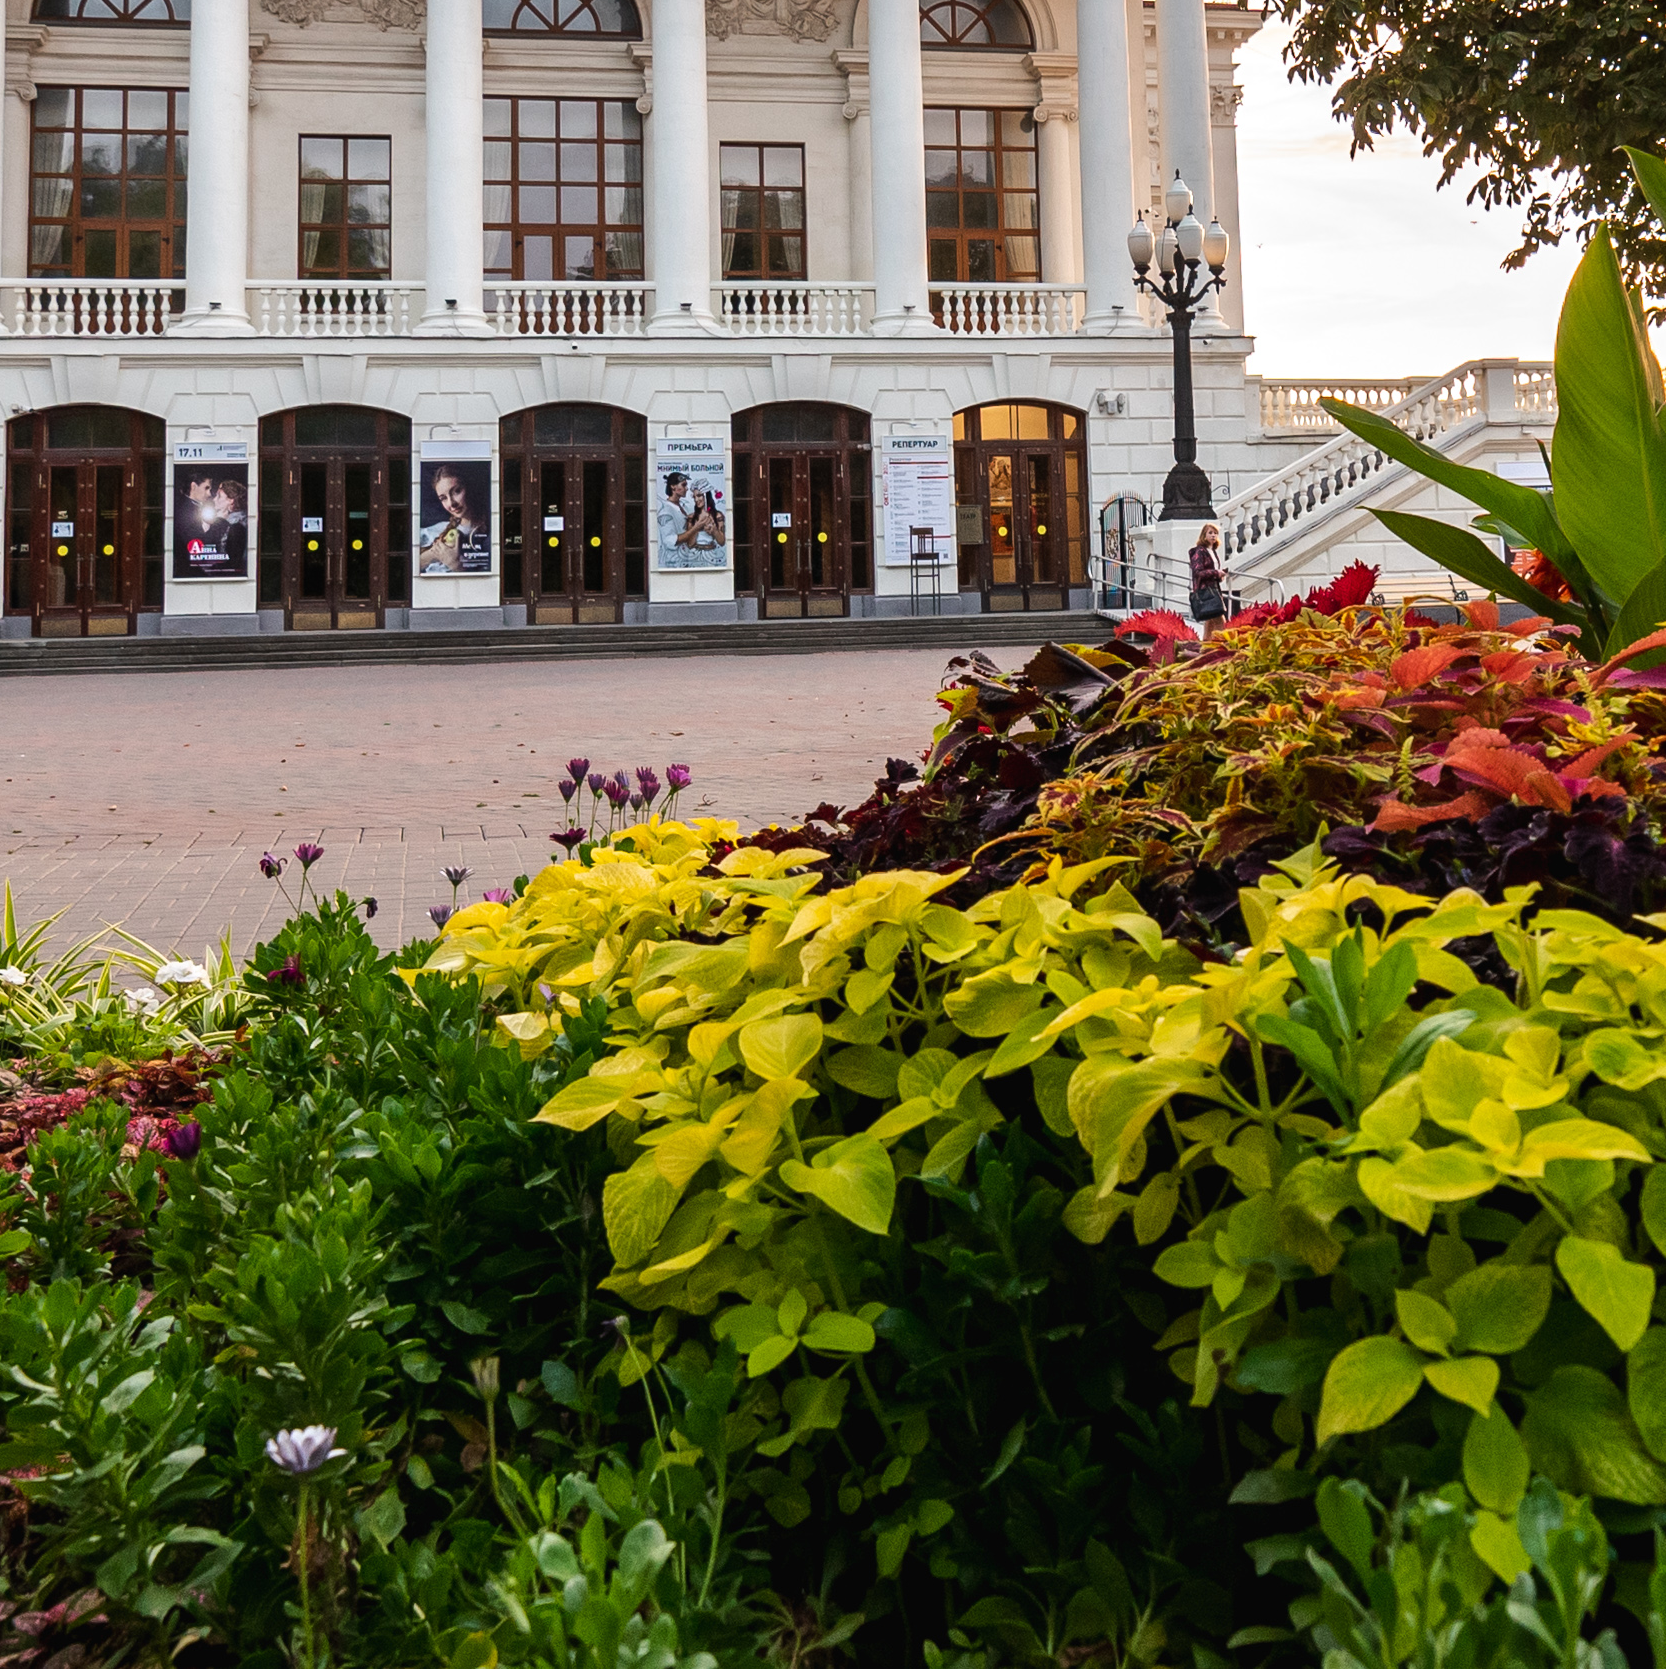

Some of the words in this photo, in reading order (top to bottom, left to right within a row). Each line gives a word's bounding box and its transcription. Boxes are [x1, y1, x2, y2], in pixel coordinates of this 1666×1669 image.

[667, 443, 714, 451] ПРЕМЬЕРА
[891, 440, 938, 448] РЕПЕРТУАР
[178, 448, 203, 457] 17.11
[657, 463, 690, 472] МНИМЫЙ
[691, 462, 724, 471] БОЛЬНОЙ
